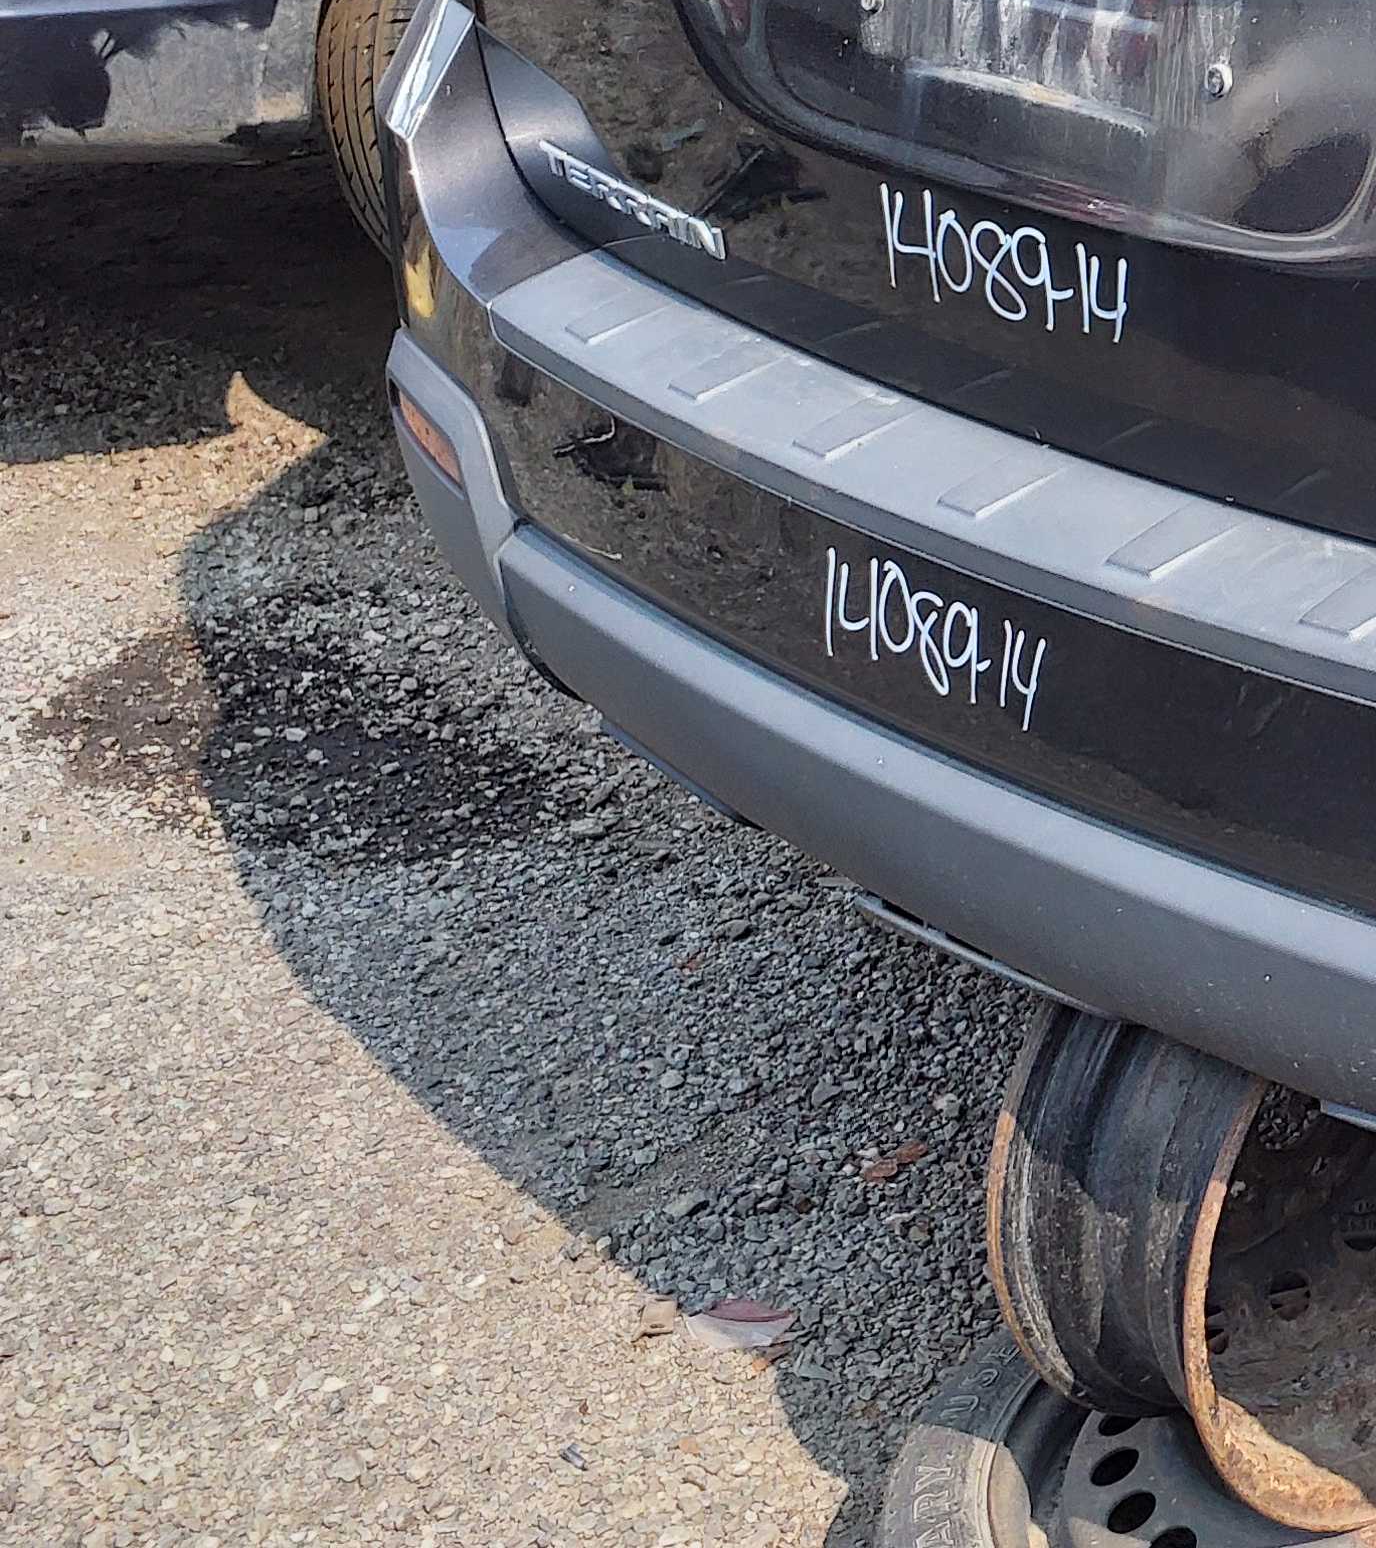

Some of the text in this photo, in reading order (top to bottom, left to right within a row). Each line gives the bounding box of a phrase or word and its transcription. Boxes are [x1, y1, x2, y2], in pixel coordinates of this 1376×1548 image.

[538, 139, 727, 261] TERRAIN
[880, 181, 1129, 344] 14089-14
[825, 547, 1046, 731] 14089-14
